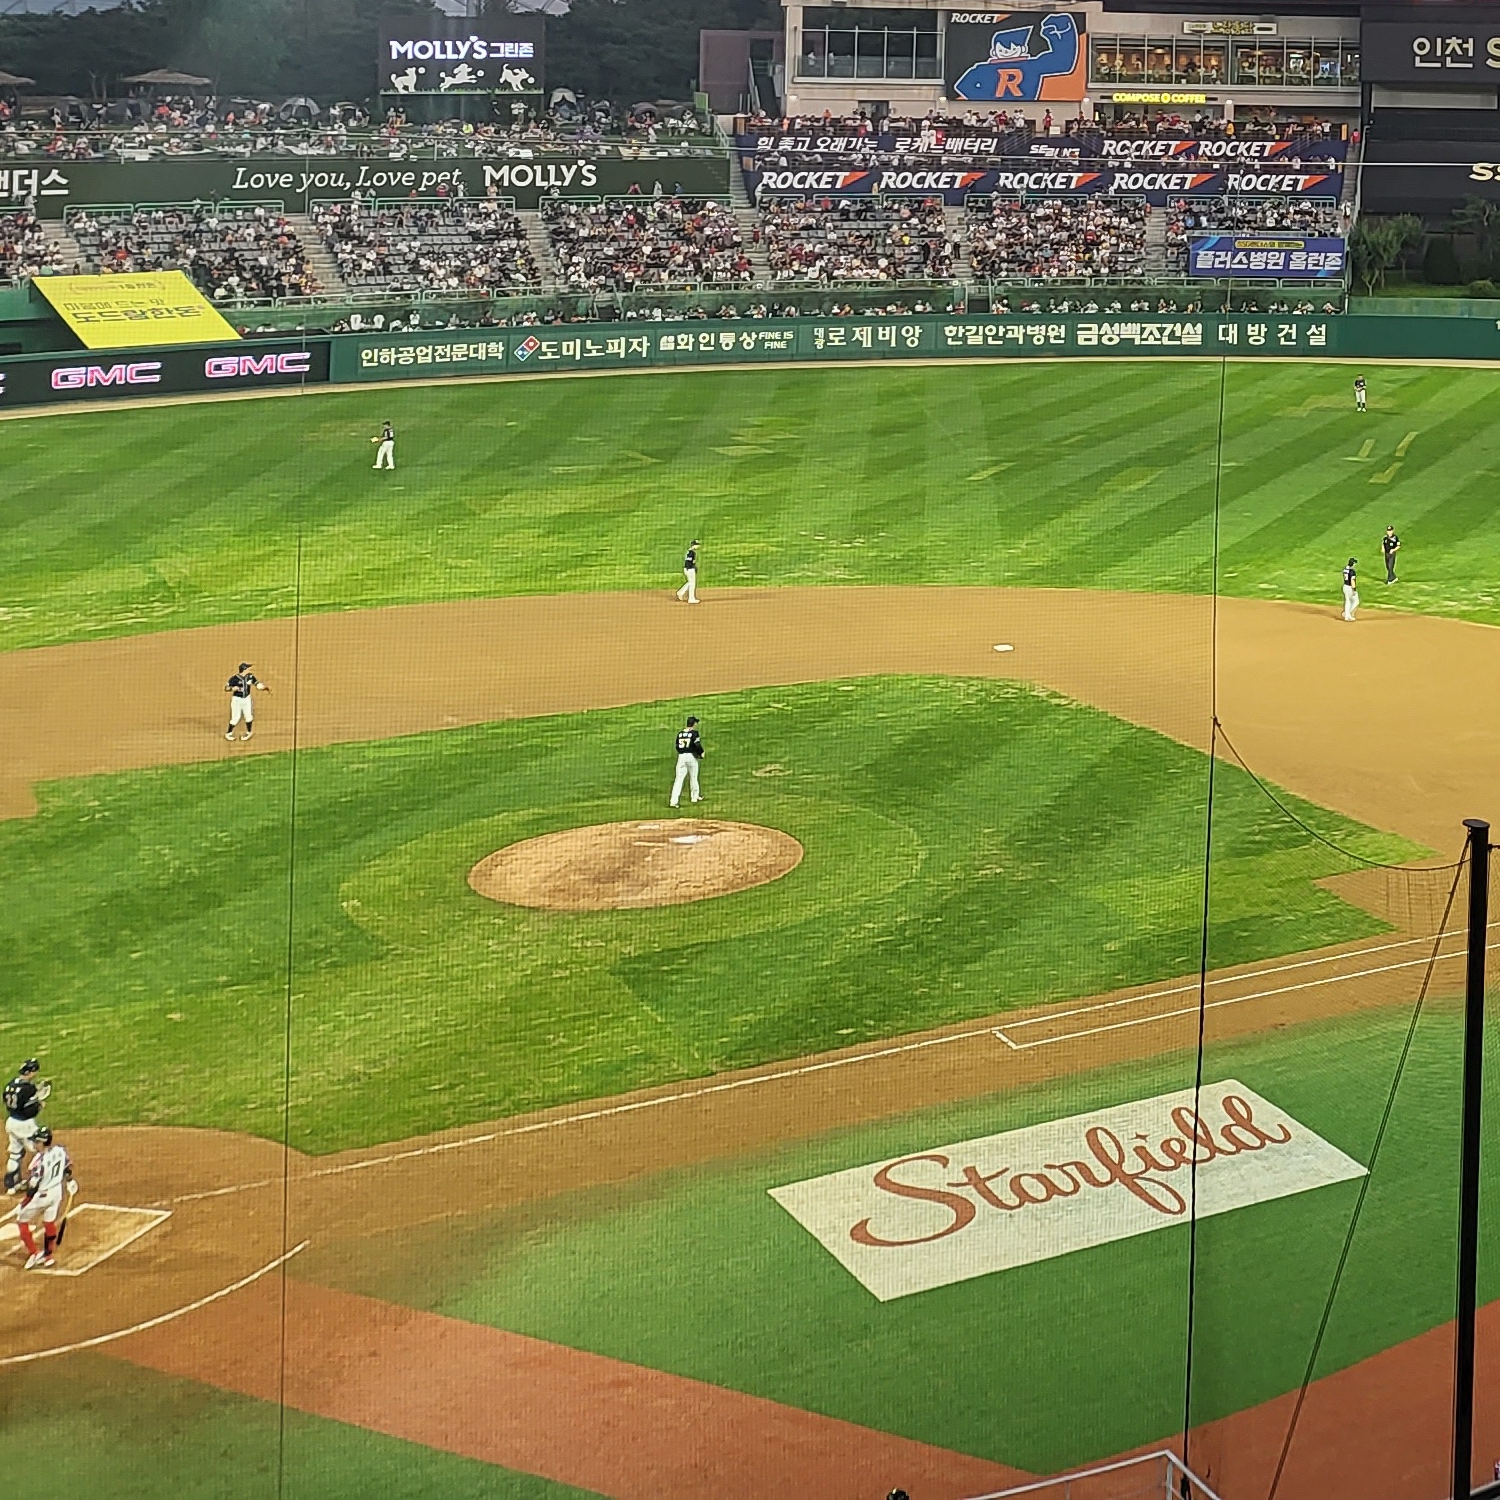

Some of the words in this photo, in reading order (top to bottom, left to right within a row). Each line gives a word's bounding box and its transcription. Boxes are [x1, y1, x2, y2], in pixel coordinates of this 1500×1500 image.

[951, 13, 1001, 24] ROCKET
[389, 36, 488, 60] MOLLY'S
[489, 41, 534, 59] 그린존
[1412, 36, 1475, 69] 인천
[994, 68, 1025, 98] R
[1112, 92, 1160, 103] COMPOSE
[1171, 93, 1206, 104] COFFEE
[756, 136, 769, 151] 힘
[778, 136, 810, 151] 좋고
[1101, 139, 1182, 157] ROCKET
[1197, 140, 1276, 158] ROCKET
[232, 167, 294, 189] Love
[296, 173, 352, 192] you,
[355, 166, 416, 187] Love
[483, 160, 598, 188] MOLLY'S
[761, 171, 849, 190] ROCKET
[880, 171, 968, 190] ROCKET
[998, 172, 1085, 190] ROCKET
[1112, 173, 1199, 191] ROCKET
[1227, 174, 1310, 192] ROCKET
[1195, 250, 1286, 270] 플러스병원
[1288, 252, 1343, 271] 홈런존
[758, 331, 783, 341] FINE
[783, 330, 794, 340] IS
[764, 340, 788, 350] FINE
[826, 325, 923, 349] 로제비앙
[943, 323, 1067, 347] 한길안과병원
[1076, 323, 1203, 346] 금성백조건설
[361, 341, 505, 368] 인하공업전문대학
[537, 335, 651, 361] 도미노피자
[52, 361, 163, 390] GMC
[205, 352, 311, 379] GMC
[849, 1094, 1292, 1248] Starfield
